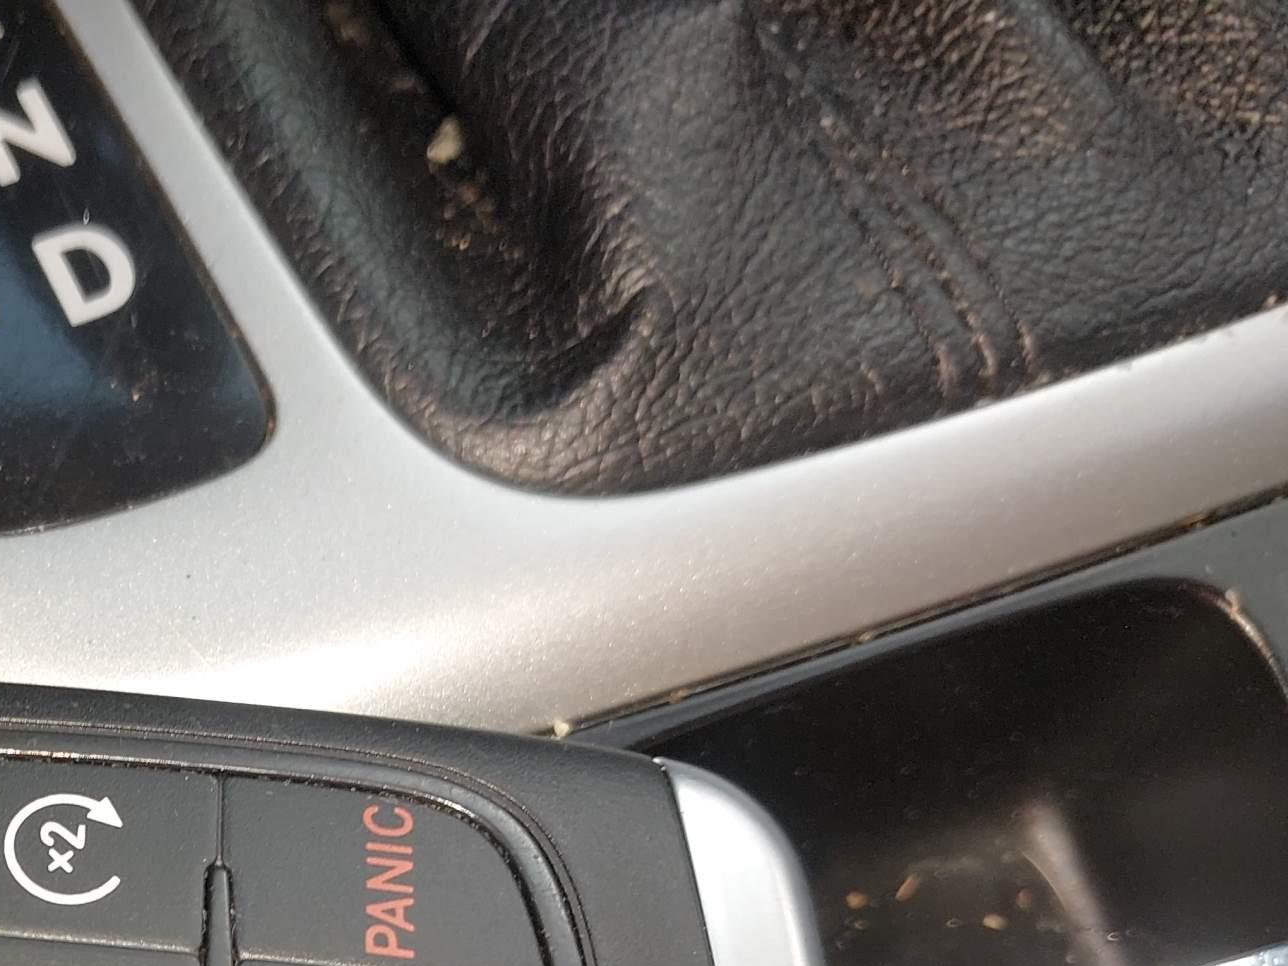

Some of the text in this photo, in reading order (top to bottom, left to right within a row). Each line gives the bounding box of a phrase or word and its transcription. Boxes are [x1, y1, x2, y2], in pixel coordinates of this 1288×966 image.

[31, 225, 135, 327] D
[40, 821, 86, 873] x2
[363, 805, 415, 959] PANIC
